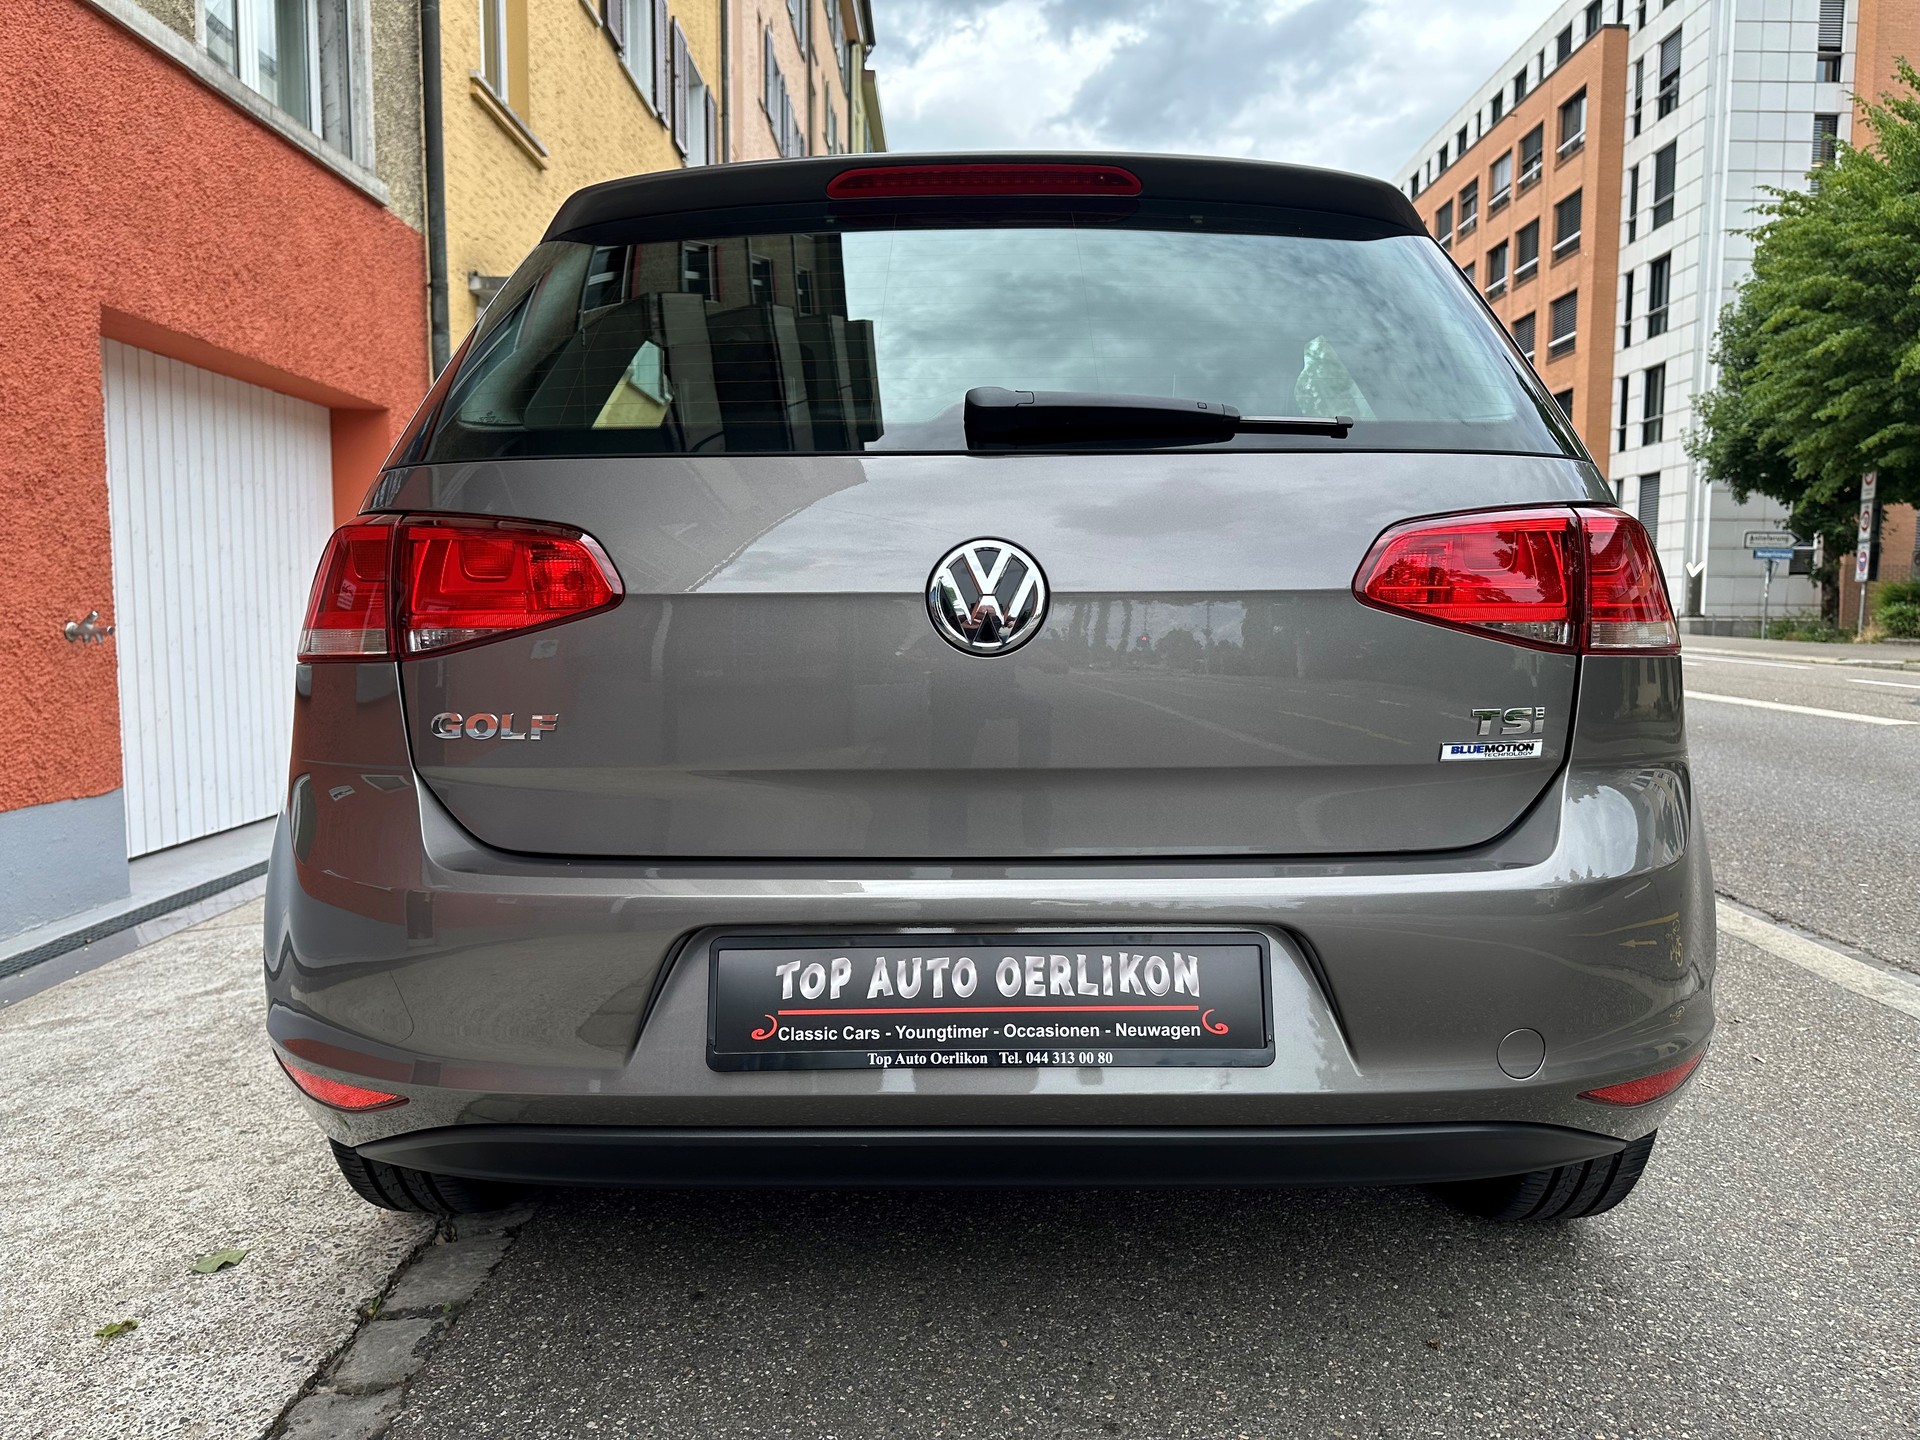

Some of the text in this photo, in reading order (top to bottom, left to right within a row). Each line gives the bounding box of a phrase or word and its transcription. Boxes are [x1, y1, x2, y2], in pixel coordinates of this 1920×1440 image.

[934, 543, 1042, 651] VW
[430, 712, 559, 740] GOLF
[1450, 743, 1535, 755] BLUEMOTION
[776, 952, 1200, 1000] TOP AUTO OERLIKON
[777, 1026, 838, 1041] Classic
[842, 1025, 880, 1040] Cars
[895, 1024, 989, 1042] Youngtimer
[1003, 1023, 1100, 1038] Occasionen
[1115, 1022, 1201, 1040] Neuwagen
[867, 1051, 1113, 1068] Top Auto Oerlikon Tel. 044 313 00 80
